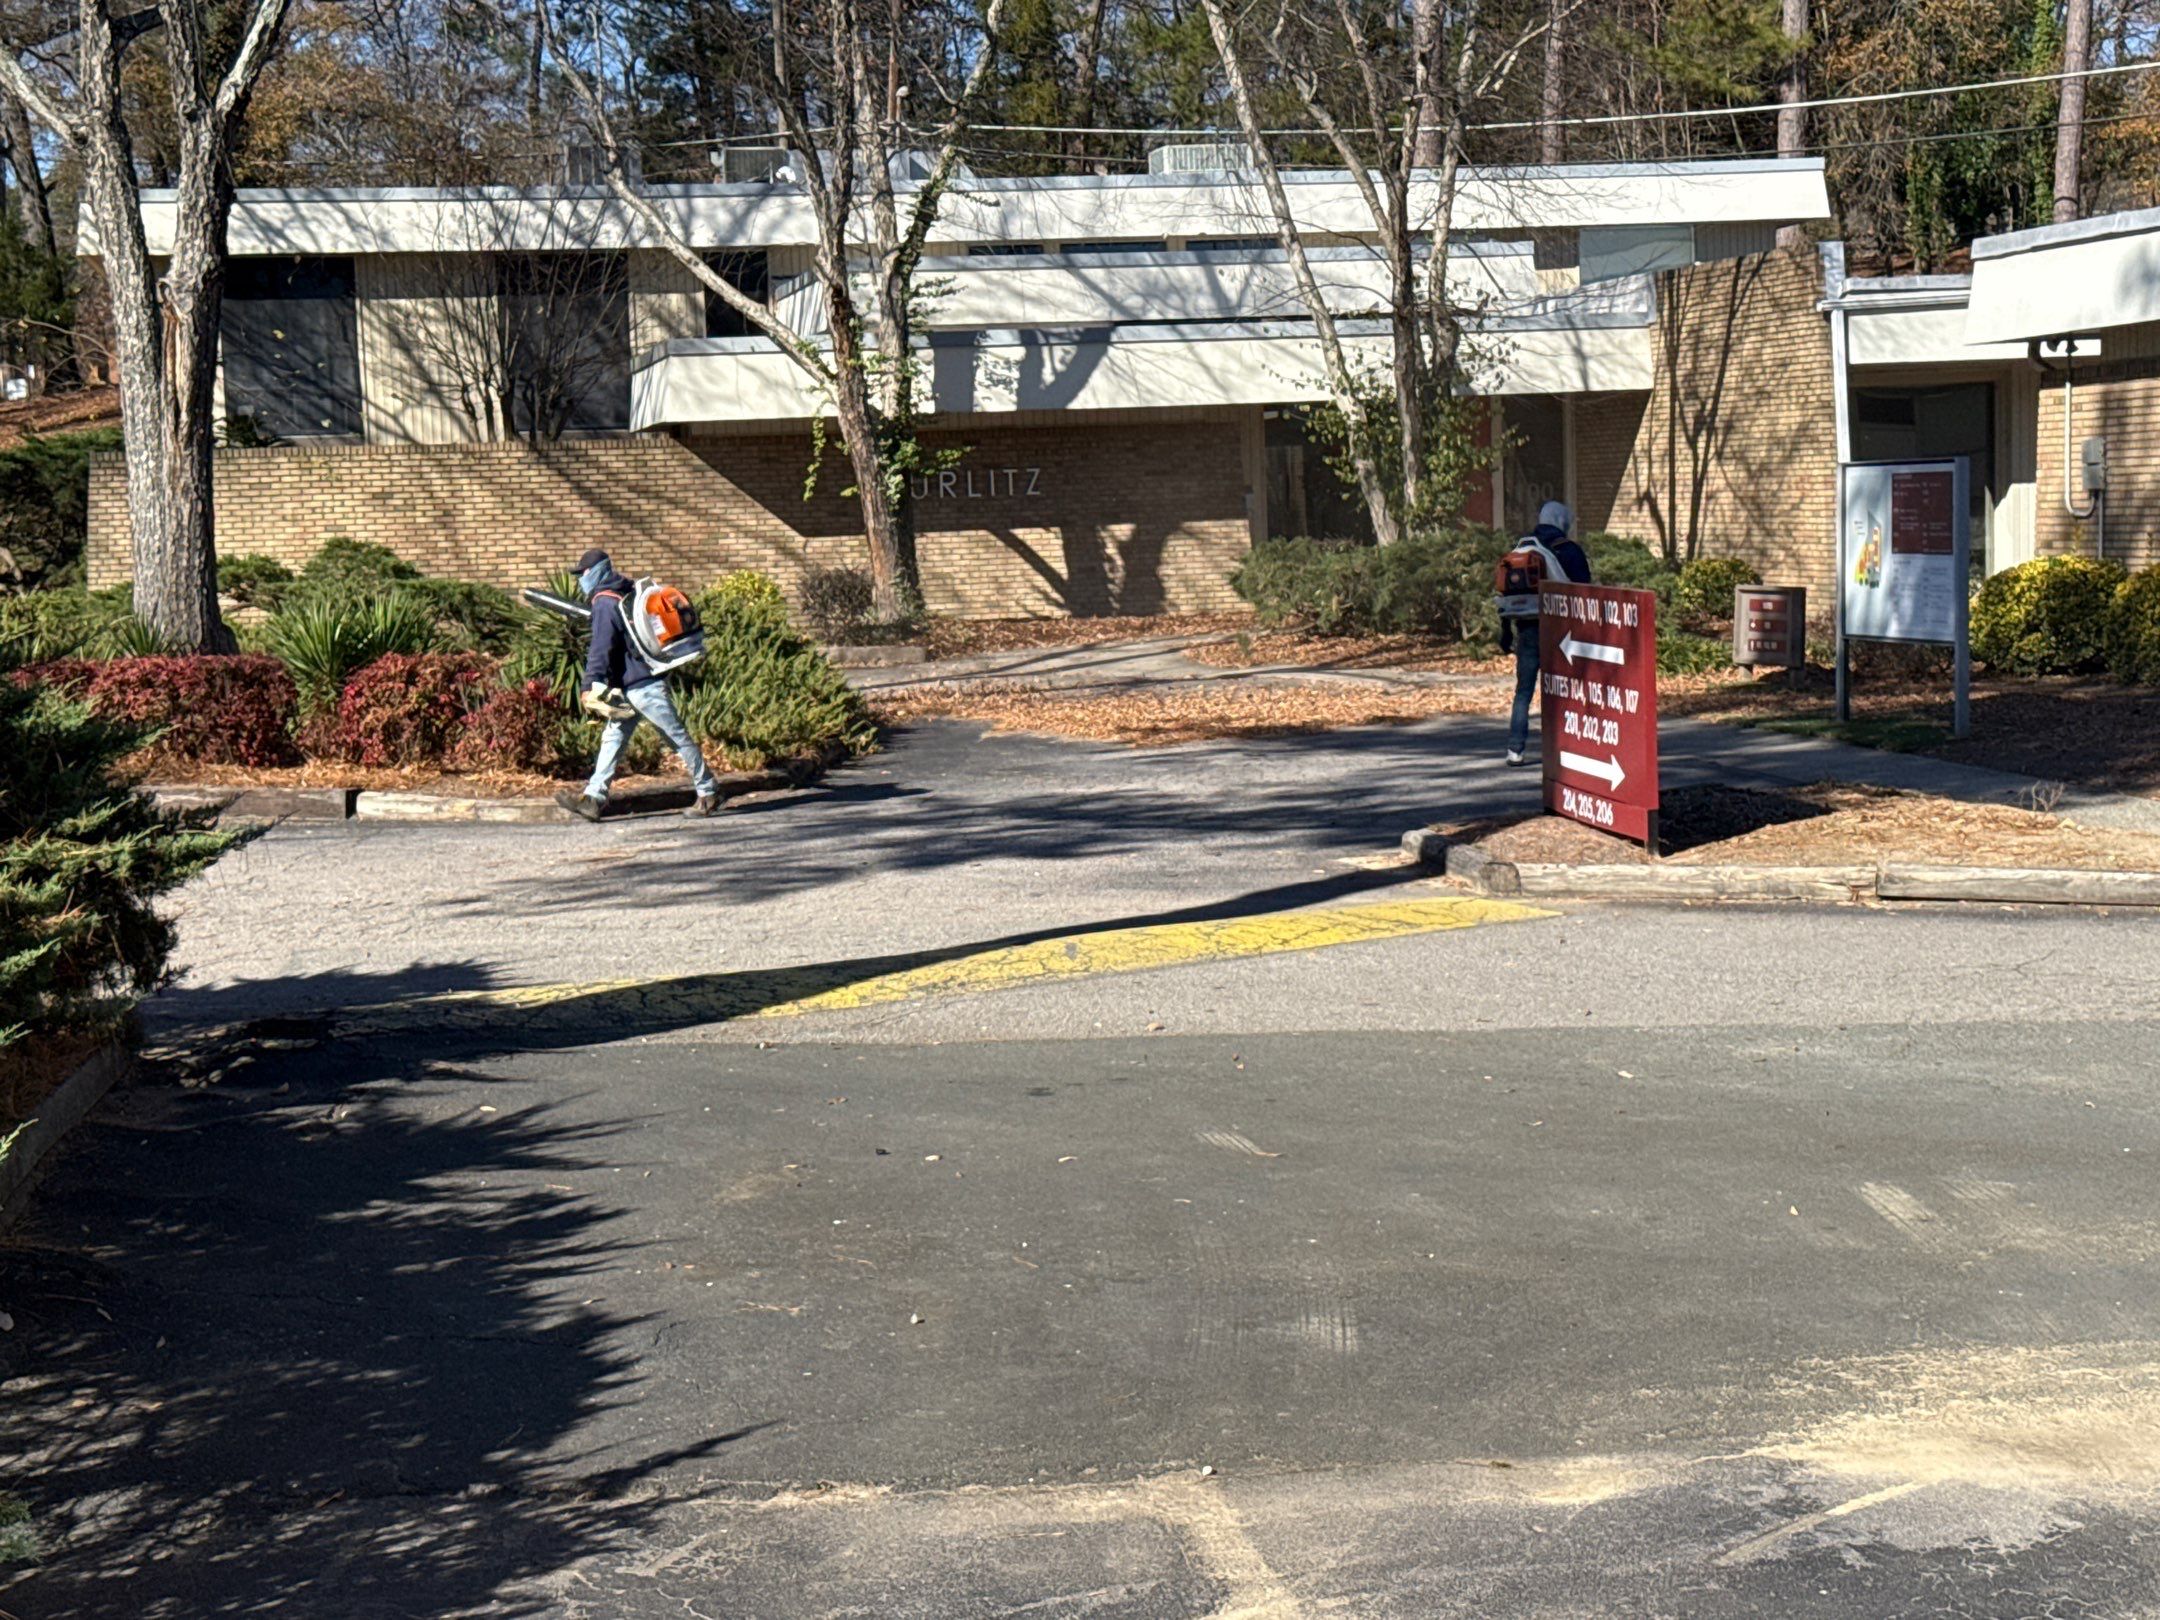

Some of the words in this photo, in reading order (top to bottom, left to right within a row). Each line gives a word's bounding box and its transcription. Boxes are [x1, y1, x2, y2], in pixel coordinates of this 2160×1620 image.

[1543, 592, 1568, 618] SUITES
[1570, 596, 1586, 624] 100,
[1586, 598, 1602, 627] 101,
[1604, 600, 1621, 630] 102,
[1623, 602, 1638, 628] 103
[1544, 672, 1569, 698] SUITES
[1570, 678, 1586, 706] 104,
[1588, 681, 1604, 710] 105,
[1607, 685, 1623, 715] 106,
[1625, 688, 1639, 714] 107
[1564, 710, 1581, 741] 201,
[1582, 714, 1600, 746] 202,
[1602, 718, 1619, 746] 203
[1563, 788, 1578, 818] 204,
[1578, 793, 1595, 824] 205,
[1596, 799, 1613, 826] 206
